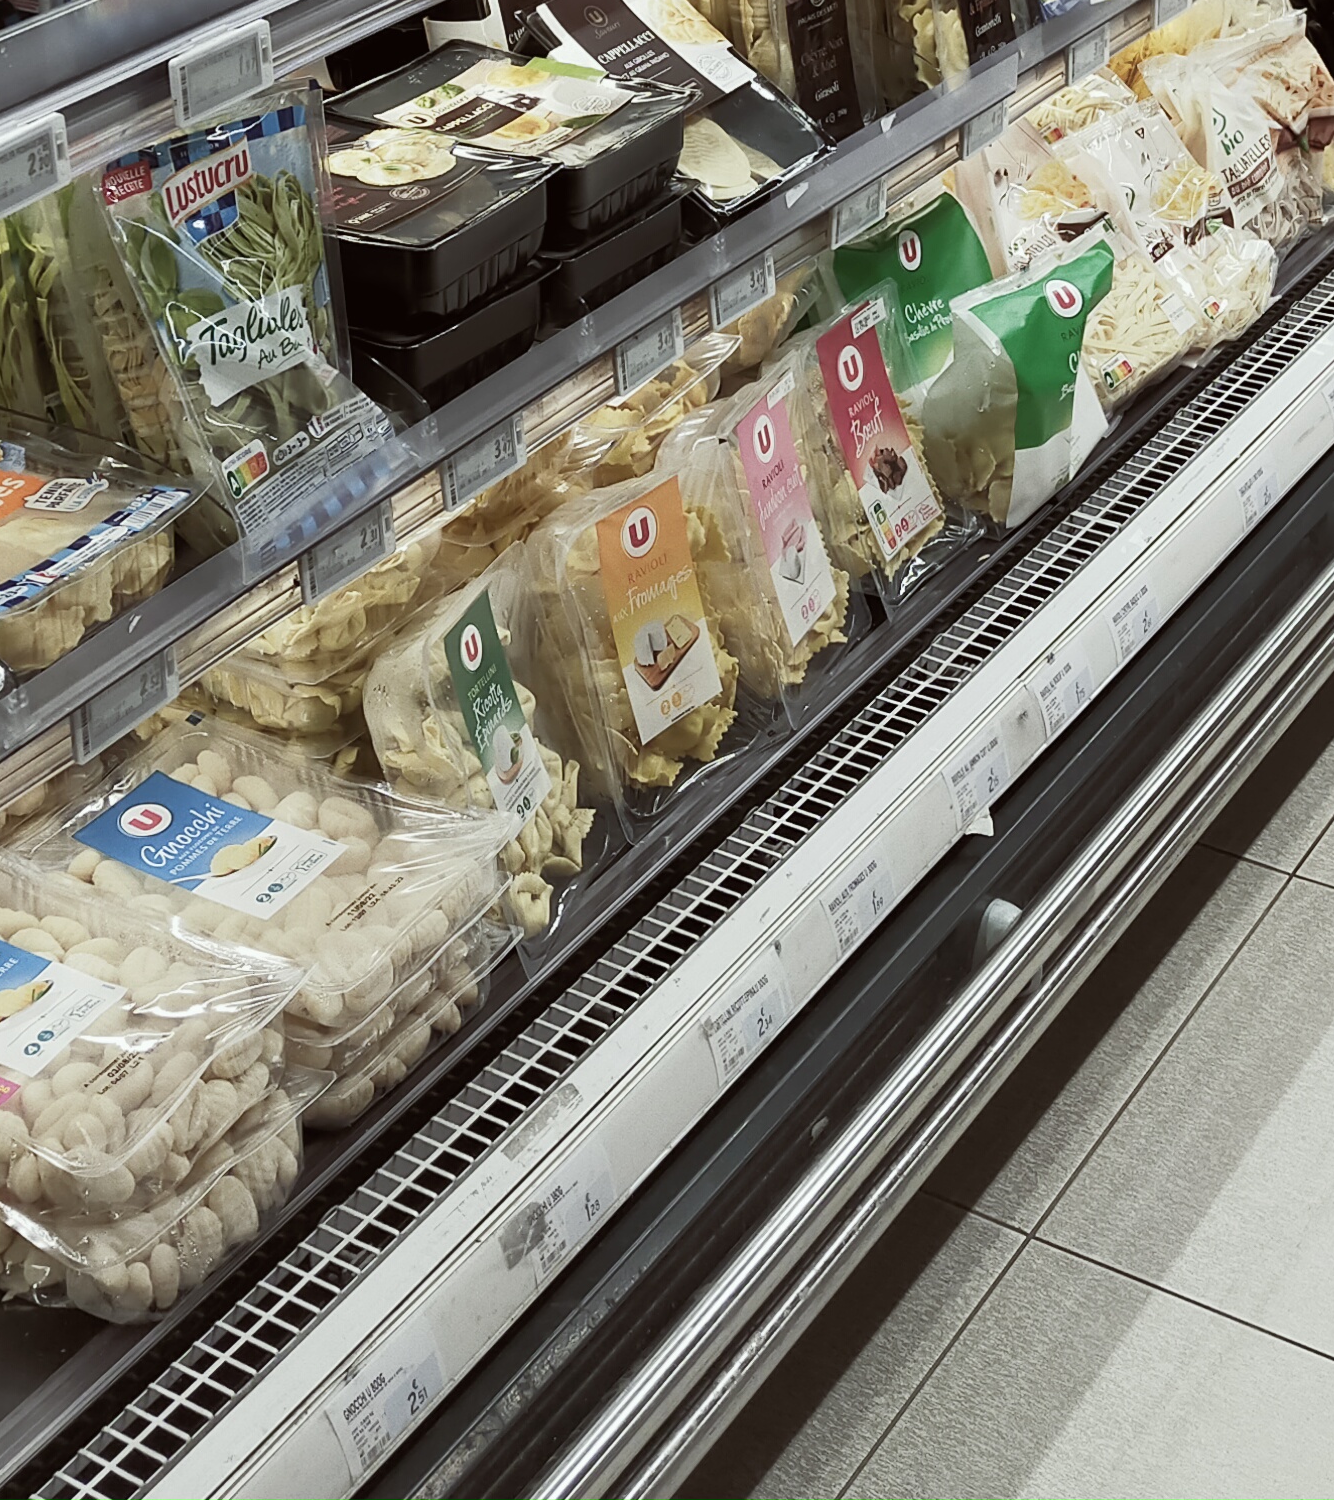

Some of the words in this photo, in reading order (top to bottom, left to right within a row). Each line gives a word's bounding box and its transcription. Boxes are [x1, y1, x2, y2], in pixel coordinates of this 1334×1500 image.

[596, 29, 656, 66] CAPPELLACCI
[904, 298, 945, 326] Chèvre
[848, 388, 878, 417] RAVIOLI
[761, 458, 786, 491] RAVIOLI
[626, 553, 669, 586] RAVIOLI
[625, 564, 693, 616] Fromages
[140, 802, 227, 871] Gnocchi
[169, 845, 208, 876] POMMES
[216, 813, 244, 840] TERRE
